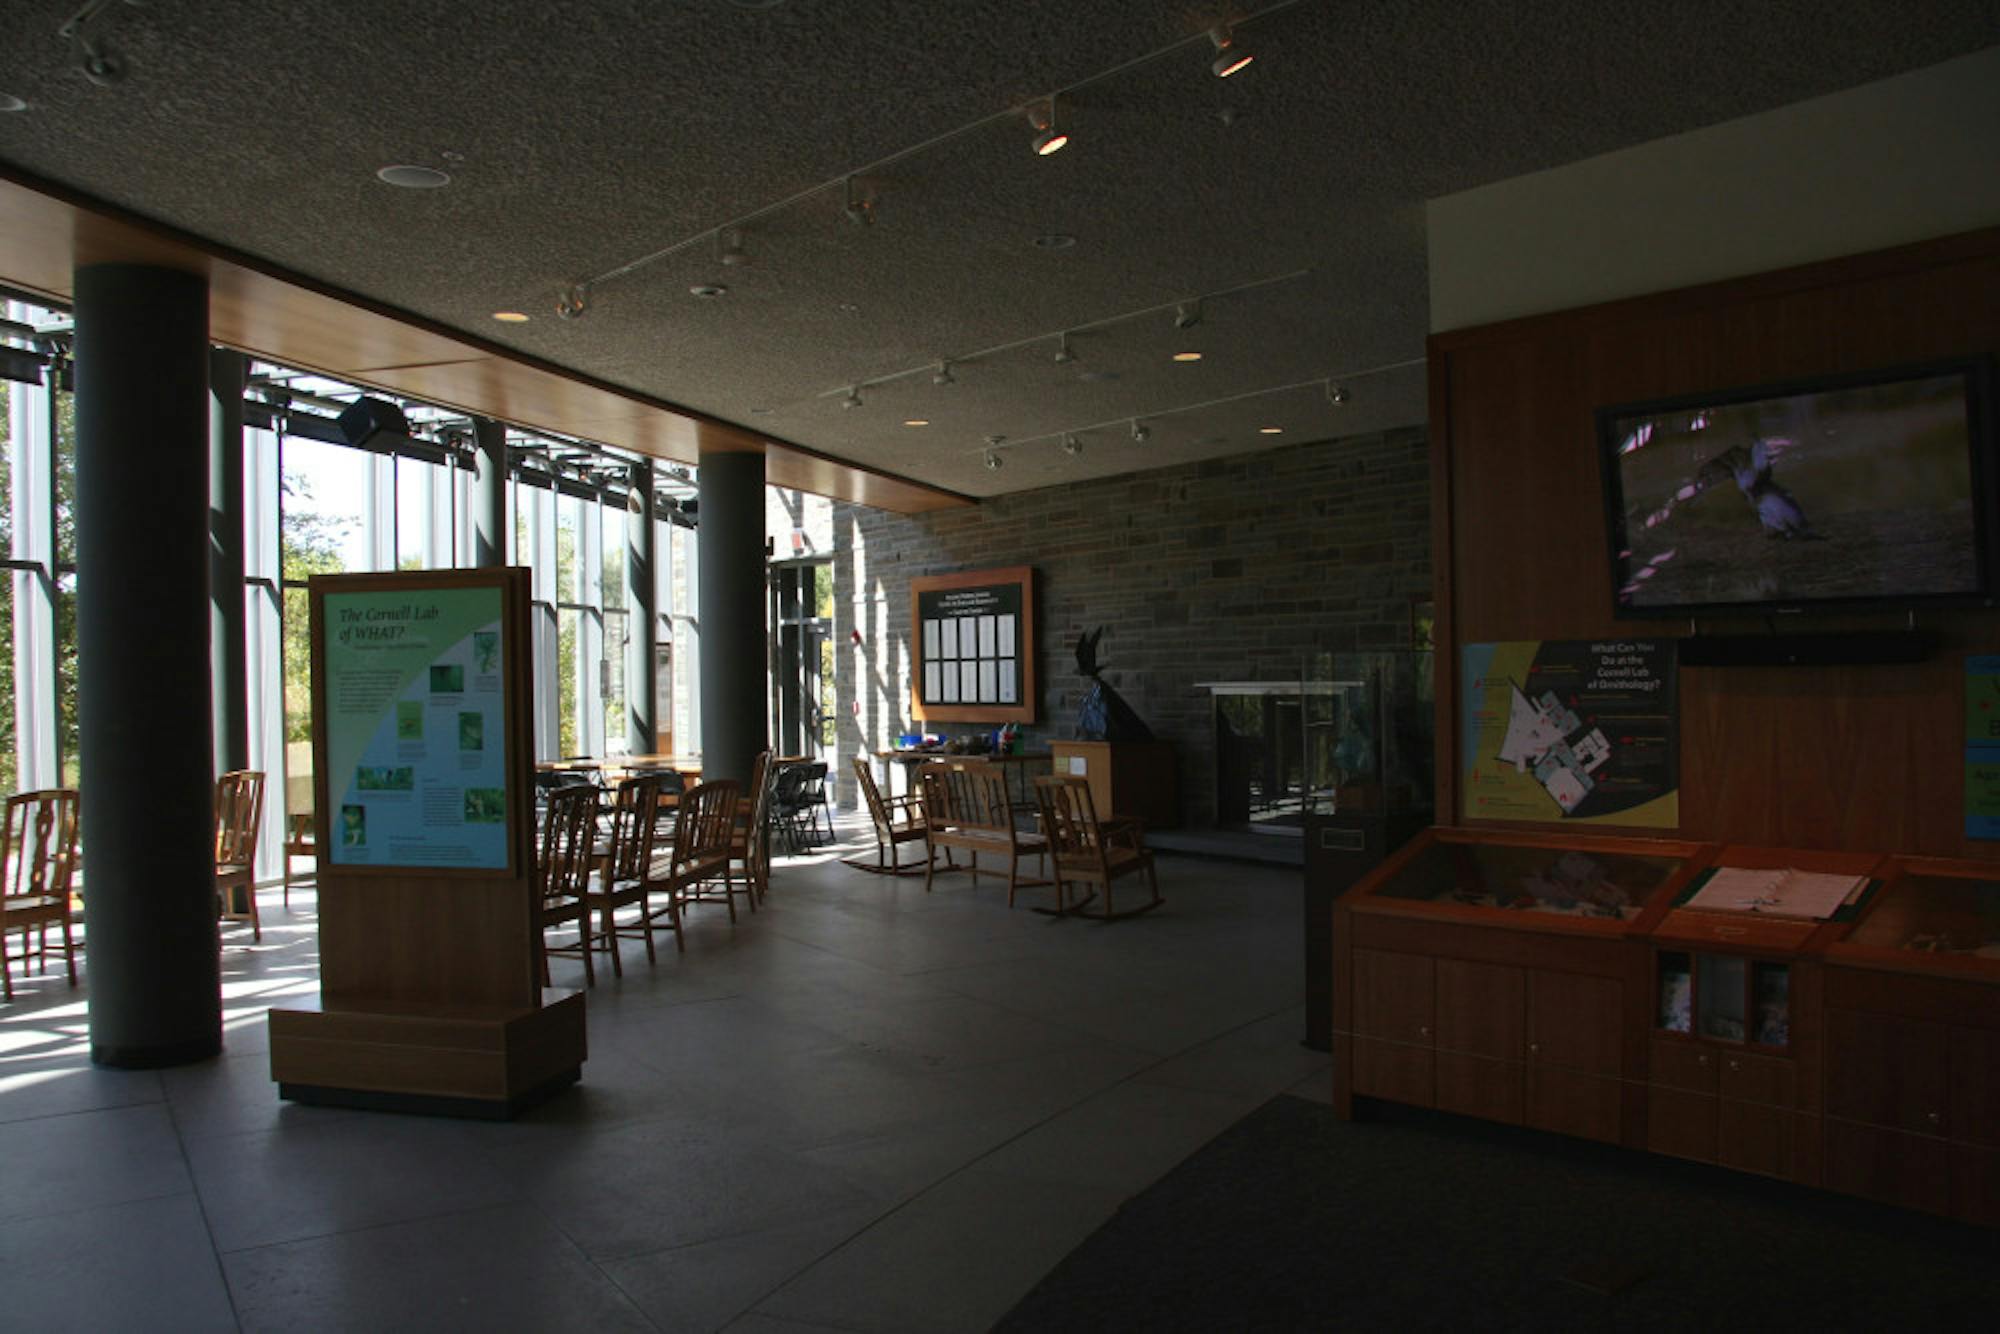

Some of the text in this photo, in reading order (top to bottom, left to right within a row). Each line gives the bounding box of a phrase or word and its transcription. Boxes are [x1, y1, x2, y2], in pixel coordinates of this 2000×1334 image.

[339, 604, 439, 622] The Cornell Lab
[339, 625, 405, 643] of WHAT?
[1592, 642, 1655, 654] What Can You
[1601, 655, 1615, 665] Do
[1628, 655, 1644, 665] the
[1597, 666, 1649, 677] Cornell Lab
[1587, 679, 1661, 692] of Ornithology?
